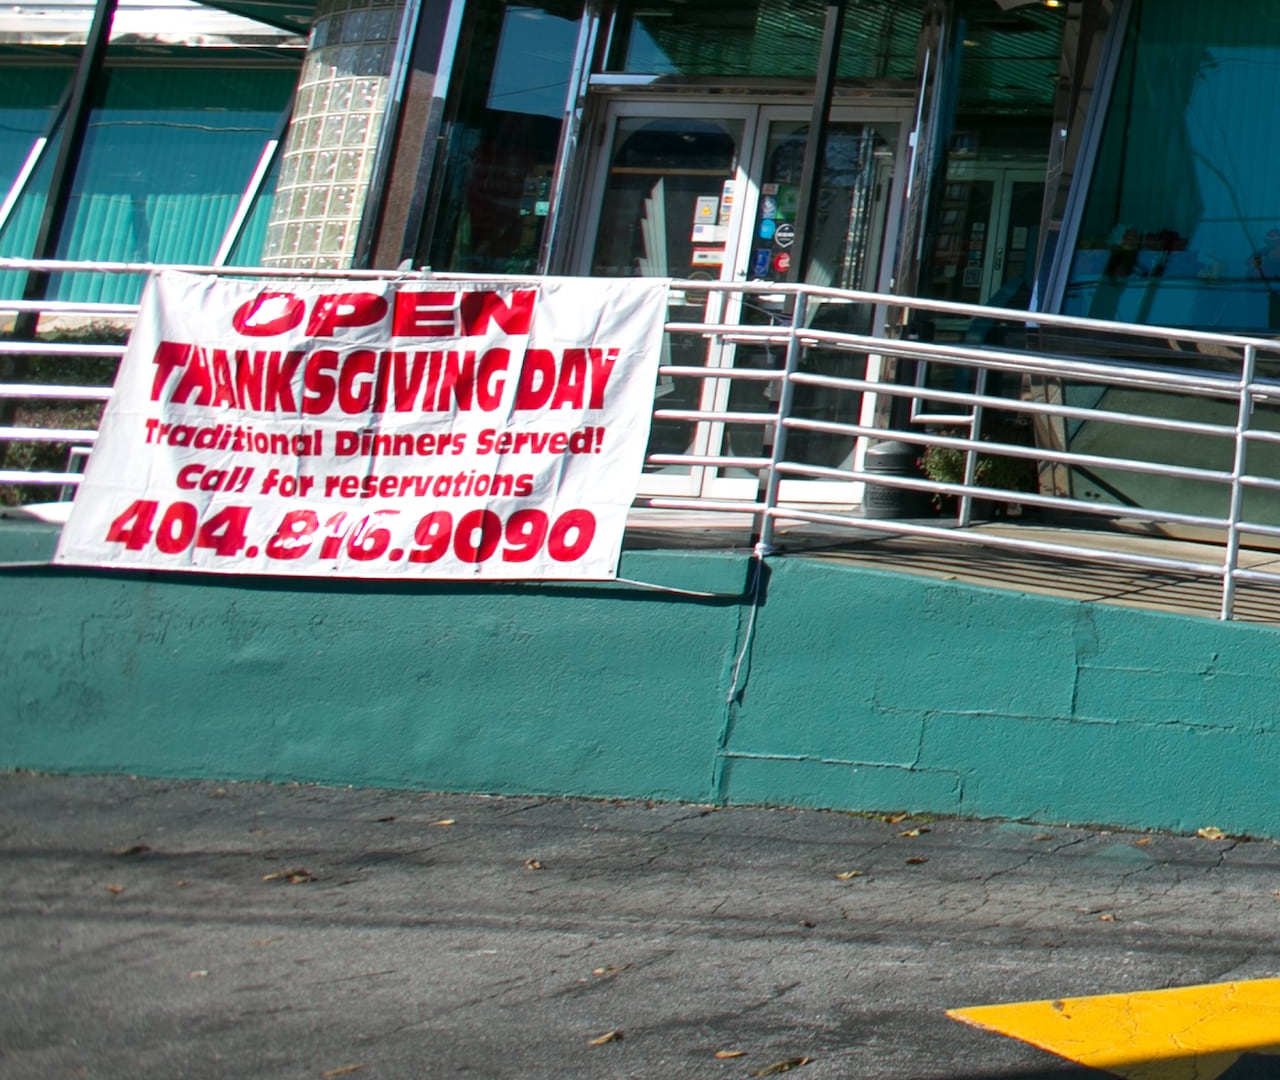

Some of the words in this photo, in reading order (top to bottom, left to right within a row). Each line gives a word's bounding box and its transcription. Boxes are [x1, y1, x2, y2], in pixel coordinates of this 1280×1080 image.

[232, 290, 537, 337] OPEN
[151, 342, 511, 415] THANKSGIVING
[515, 348, 620, 410] DAY
[146, 418, 323, 456] Traditional
[336, 431, 467, 457] Dinners
[476, 427, 605, 455] Served!
[177, 464, 252, 492] Call
[261, 469, 314, 497] for
[325, 472, 534, 498] reservations
[106, 500, 596, 563] 404.816.9090
